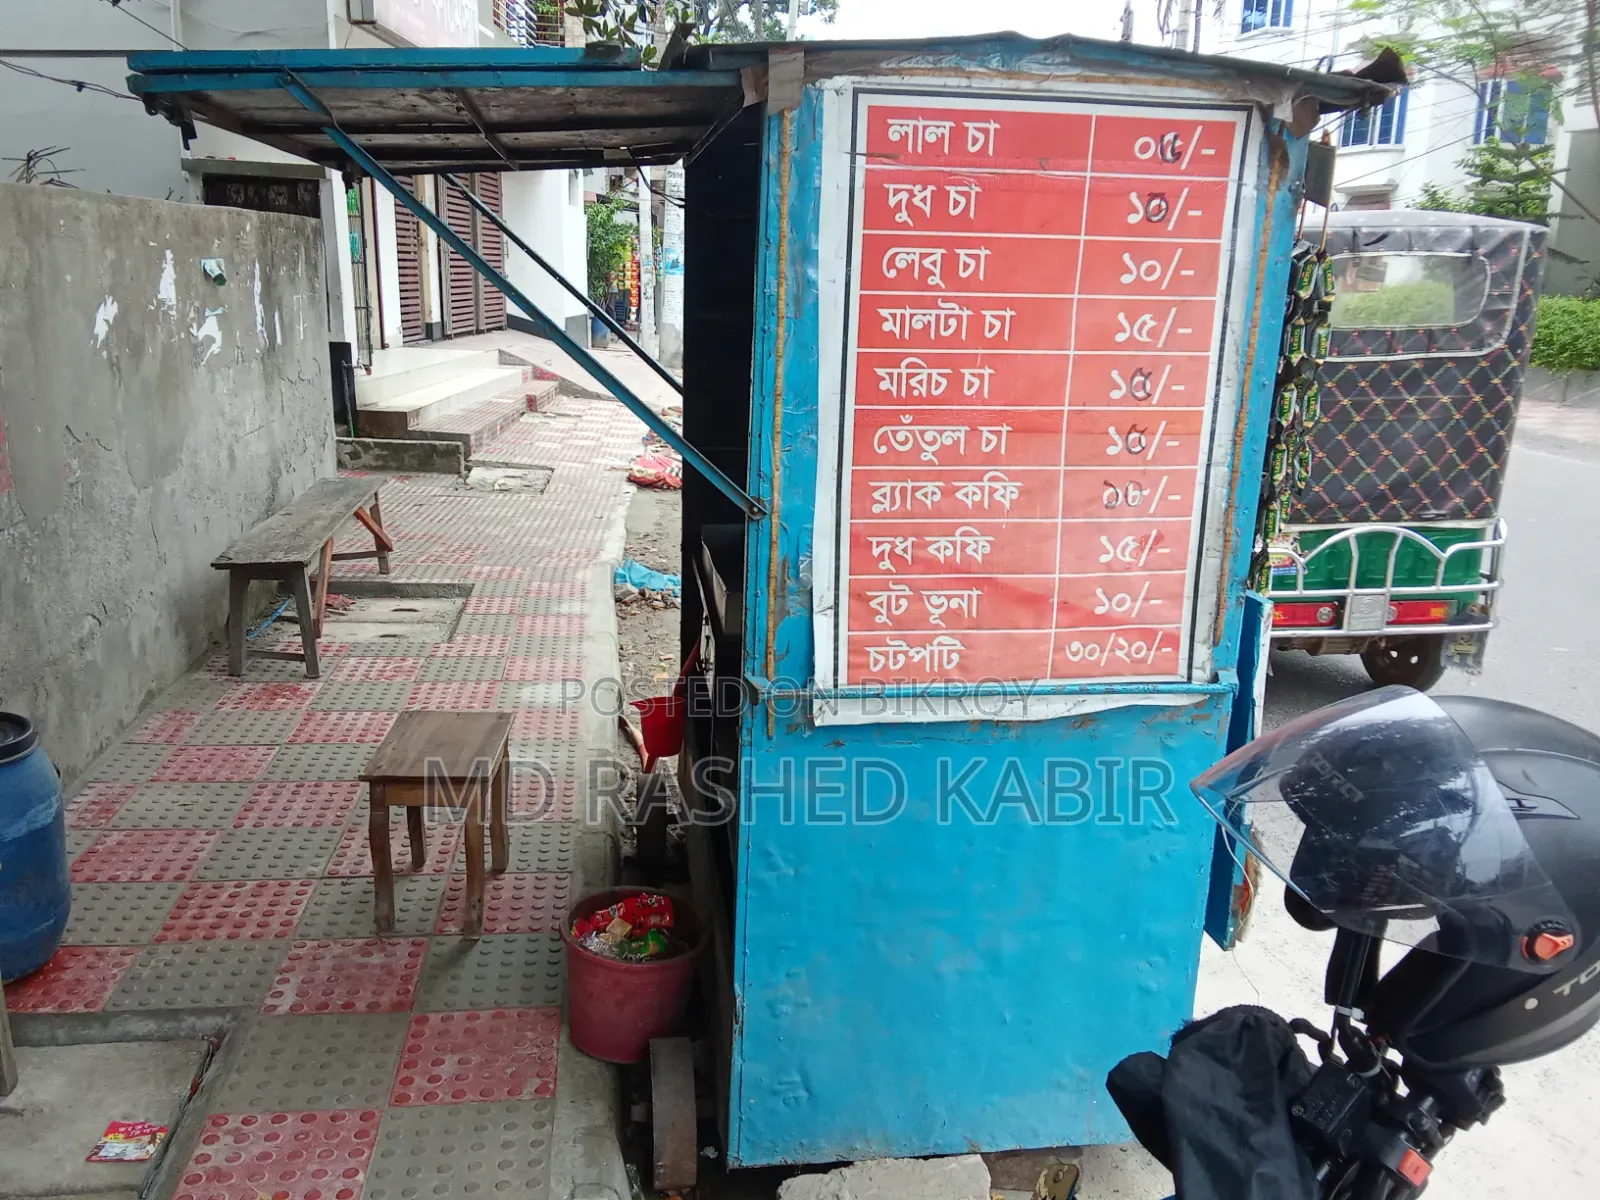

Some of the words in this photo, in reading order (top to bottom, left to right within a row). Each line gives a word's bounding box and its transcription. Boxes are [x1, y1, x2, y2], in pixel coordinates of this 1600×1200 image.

[887, 116, 955, 156] লাল
[962, 119, 1001, 158] চা
[884, 183, 936, 227] দুধ
[946, 184, 982, 220] চা
[882, 245, 947, 289] লেবু
[956, 245, 992, 281] চা
[1119, 248, 1195, 290] ১০/-
[876, 298, 974, 342] মালটা
[980, 308, 1017, 342] চা
[1114, 306, 1193, 349] ১৫/-
[873, 356, 953, 398] মরিচ
[960, 366, 997, 400] চা
[872, 414, 971, 465] তেঁতুল
[977, 423, 1013, 456] চা
[868, 478, 945, 514] ব্ল্যাক
[951, 470, 1024, 514] কফি
[867, 536, 918, 571] দুধ
[924, 525, 995, 565] কফি
[1099, 528, 1170, 567] ১৫/-
[866, 582, 914, 624] বুট
[921, 587, 983, 628] ভূনা
[1094, 580, 1163, 619] ১০/-
[864, 634, 966, 672] চটপটি
[1064, 630, 1173, 667] ৩০/২০/-
